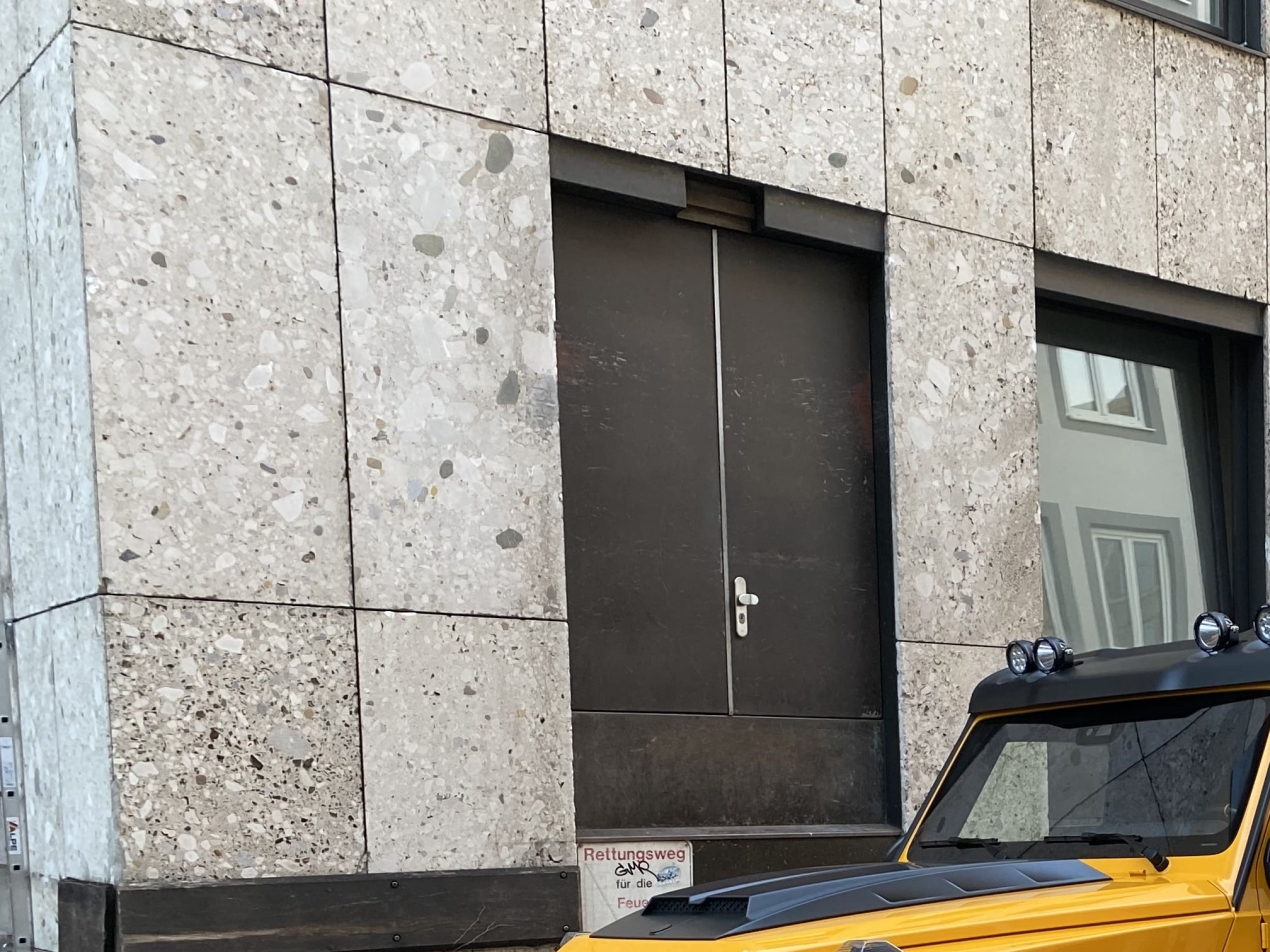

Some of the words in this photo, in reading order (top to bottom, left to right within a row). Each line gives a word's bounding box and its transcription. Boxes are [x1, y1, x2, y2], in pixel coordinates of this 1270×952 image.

[584, 847, 686, 862] Rettungsweg
[616, 879, 631, 889] für
[636, 878, 653, 888] die
